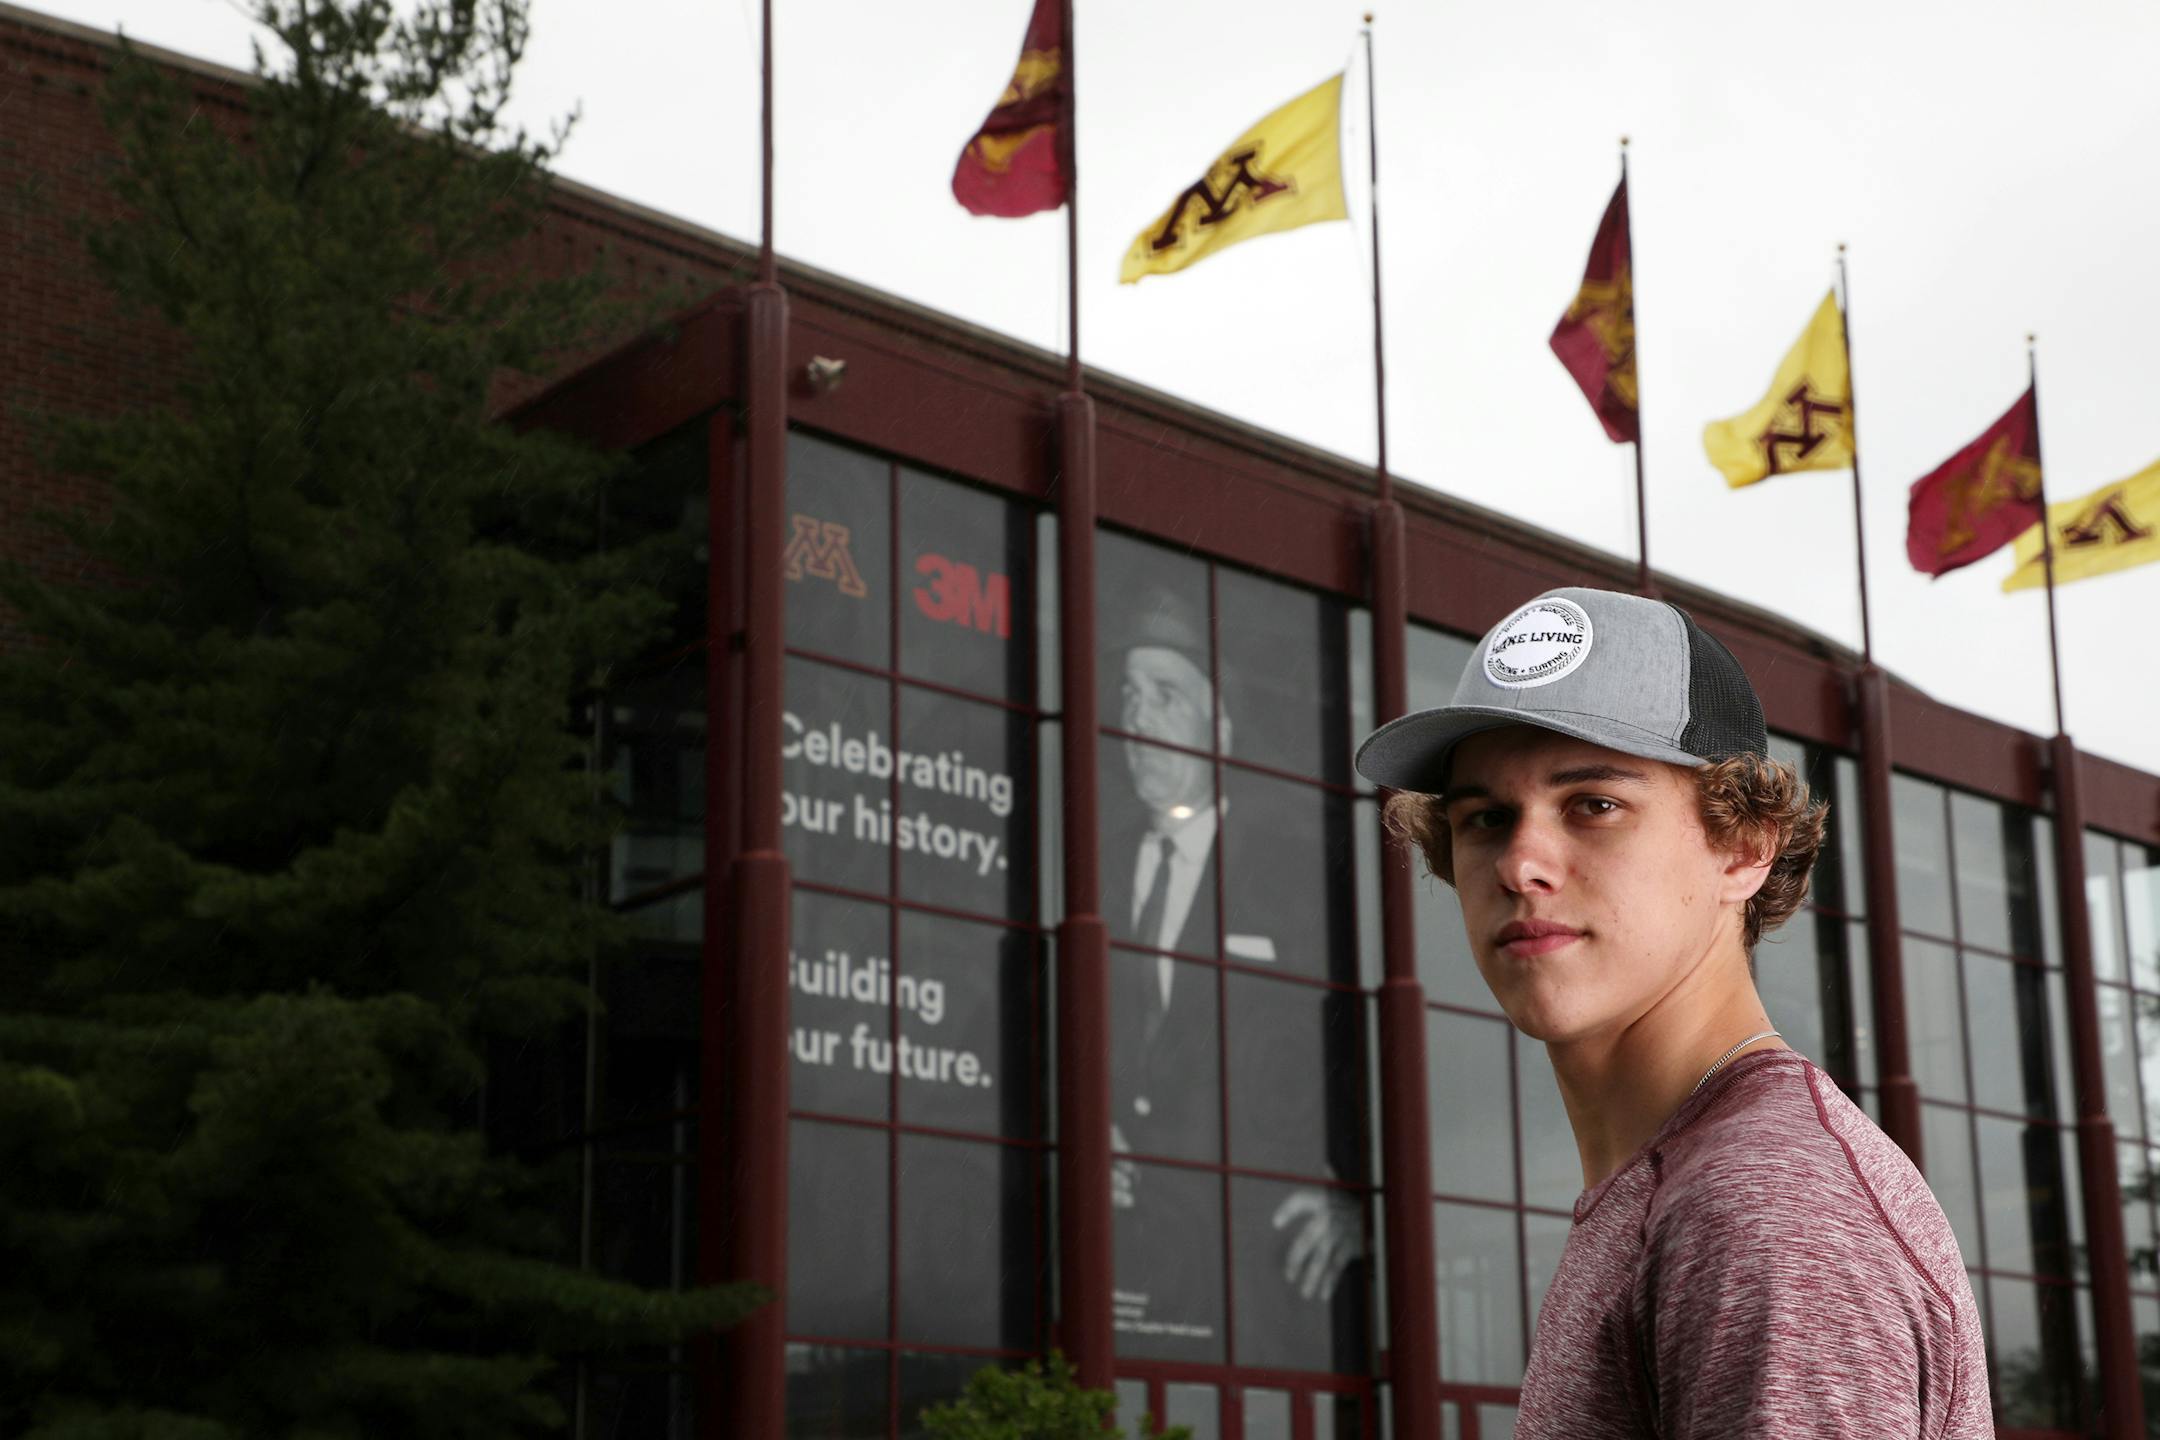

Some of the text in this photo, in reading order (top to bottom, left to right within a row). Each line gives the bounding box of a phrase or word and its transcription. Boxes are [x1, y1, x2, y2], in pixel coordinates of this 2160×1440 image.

[913, 553, 1011, 640] 3M
[1528, 651, 1568, 673] SURFING
[1530, 632, 1584, 645] LIVING
[782, 711, 1013, 817] Celebrating
[854, 795, 1008, 876] history.
[789, 1023, 993, 1089] ur future.
